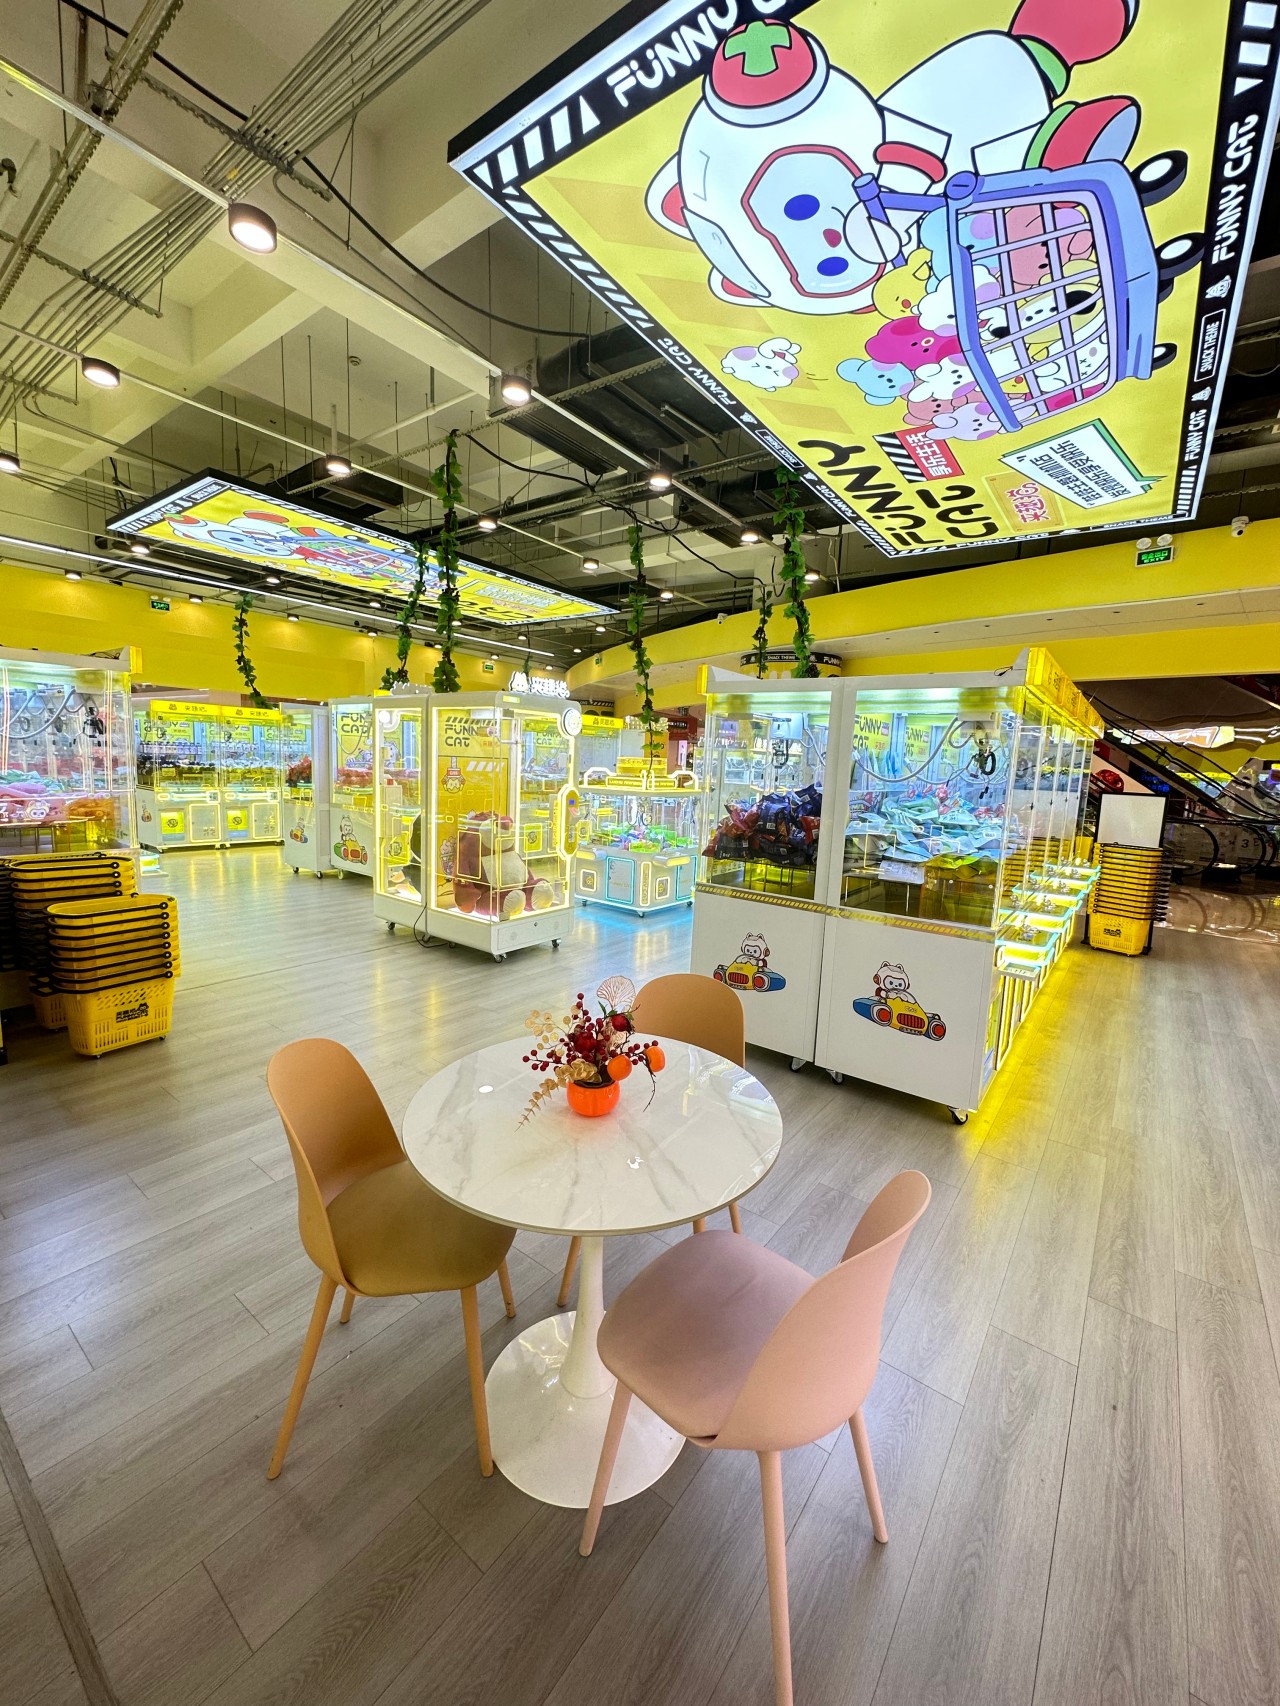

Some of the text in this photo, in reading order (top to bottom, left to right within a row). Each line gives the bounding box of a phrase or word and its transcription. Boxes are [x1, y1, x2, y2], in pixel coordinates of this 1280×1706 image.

[1223, 114, 1259, 178] CAT
[1200, 320, 1220, 373] SNACK THEME
[915, 484, 1000, 539] CAT
[1138, 515, 1175, 524] THEME
[444, 736, 471, 748] CAT
